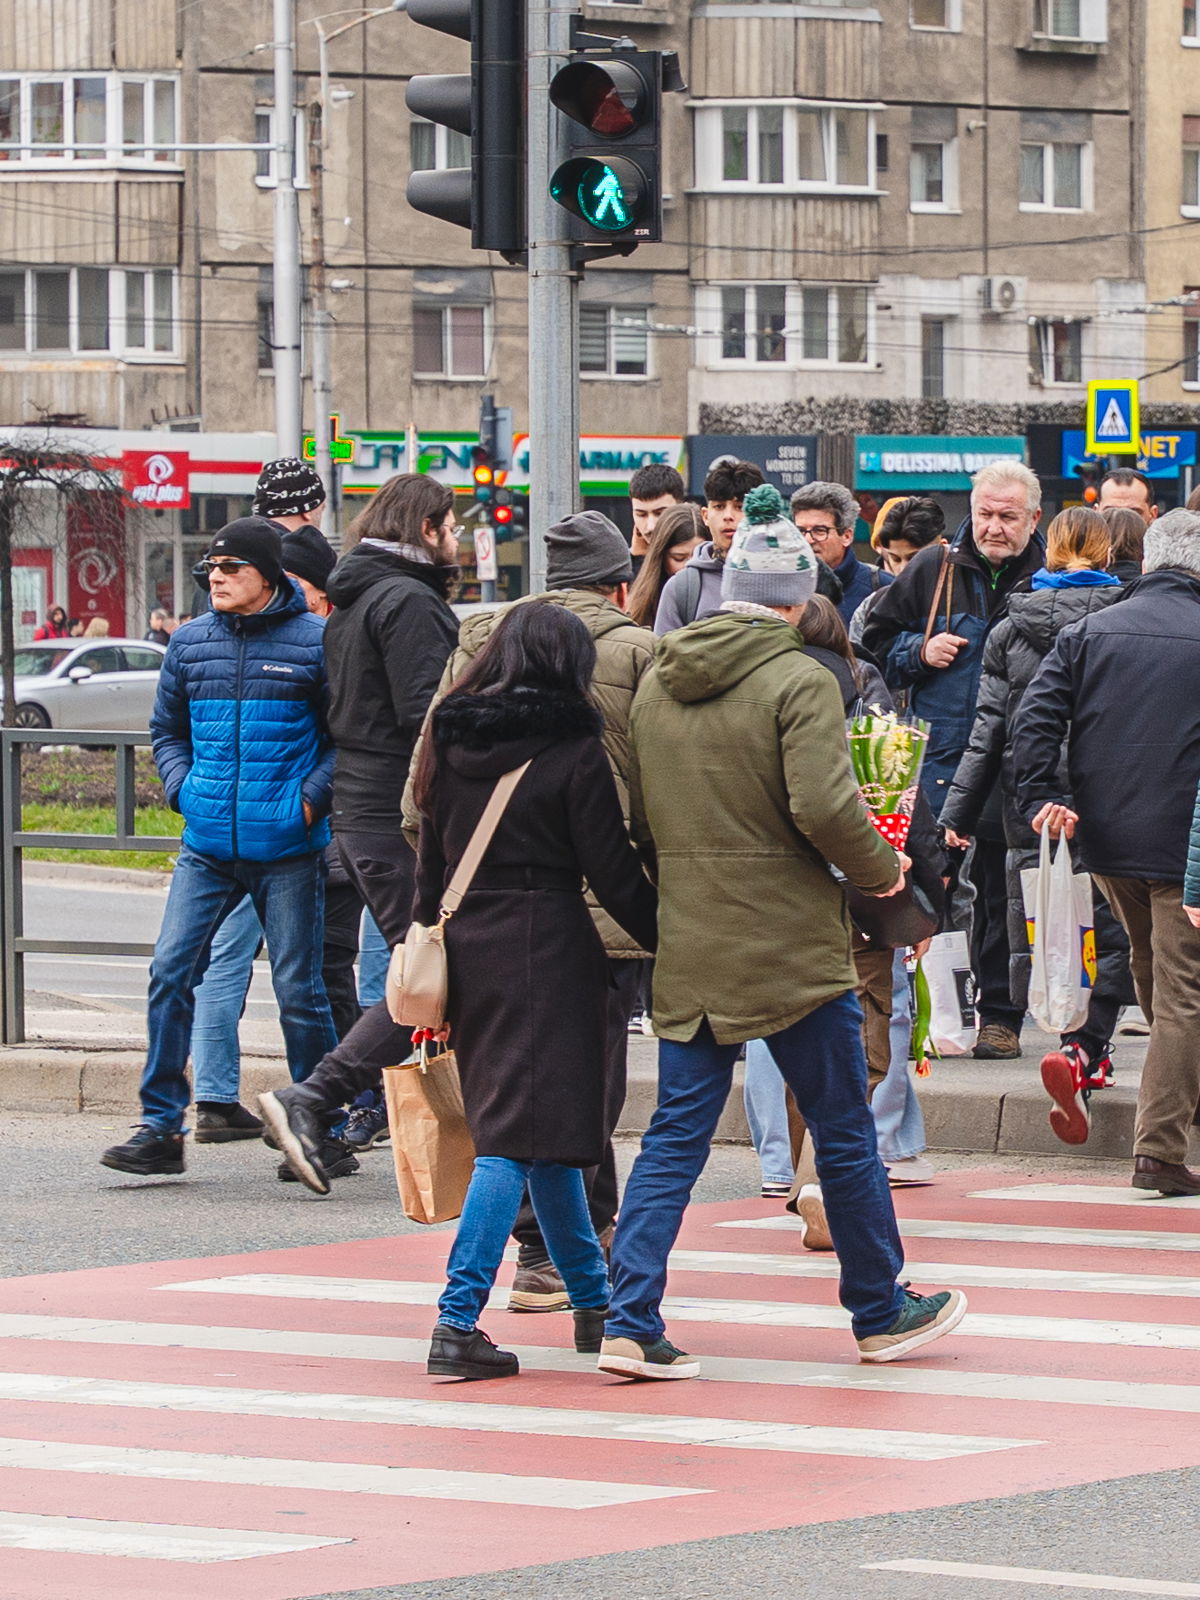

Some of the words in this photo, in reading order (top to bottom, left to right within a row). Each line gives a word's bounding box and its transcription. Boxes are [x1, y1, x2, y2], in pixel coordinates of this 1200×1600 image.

[579, 451, 669, 470] ARMACIE
[778, 446, 807, 459] SEVEN
[765, 459, 807, 472] WONDERS
[881, 452, 962, 473] DELISSIMA
